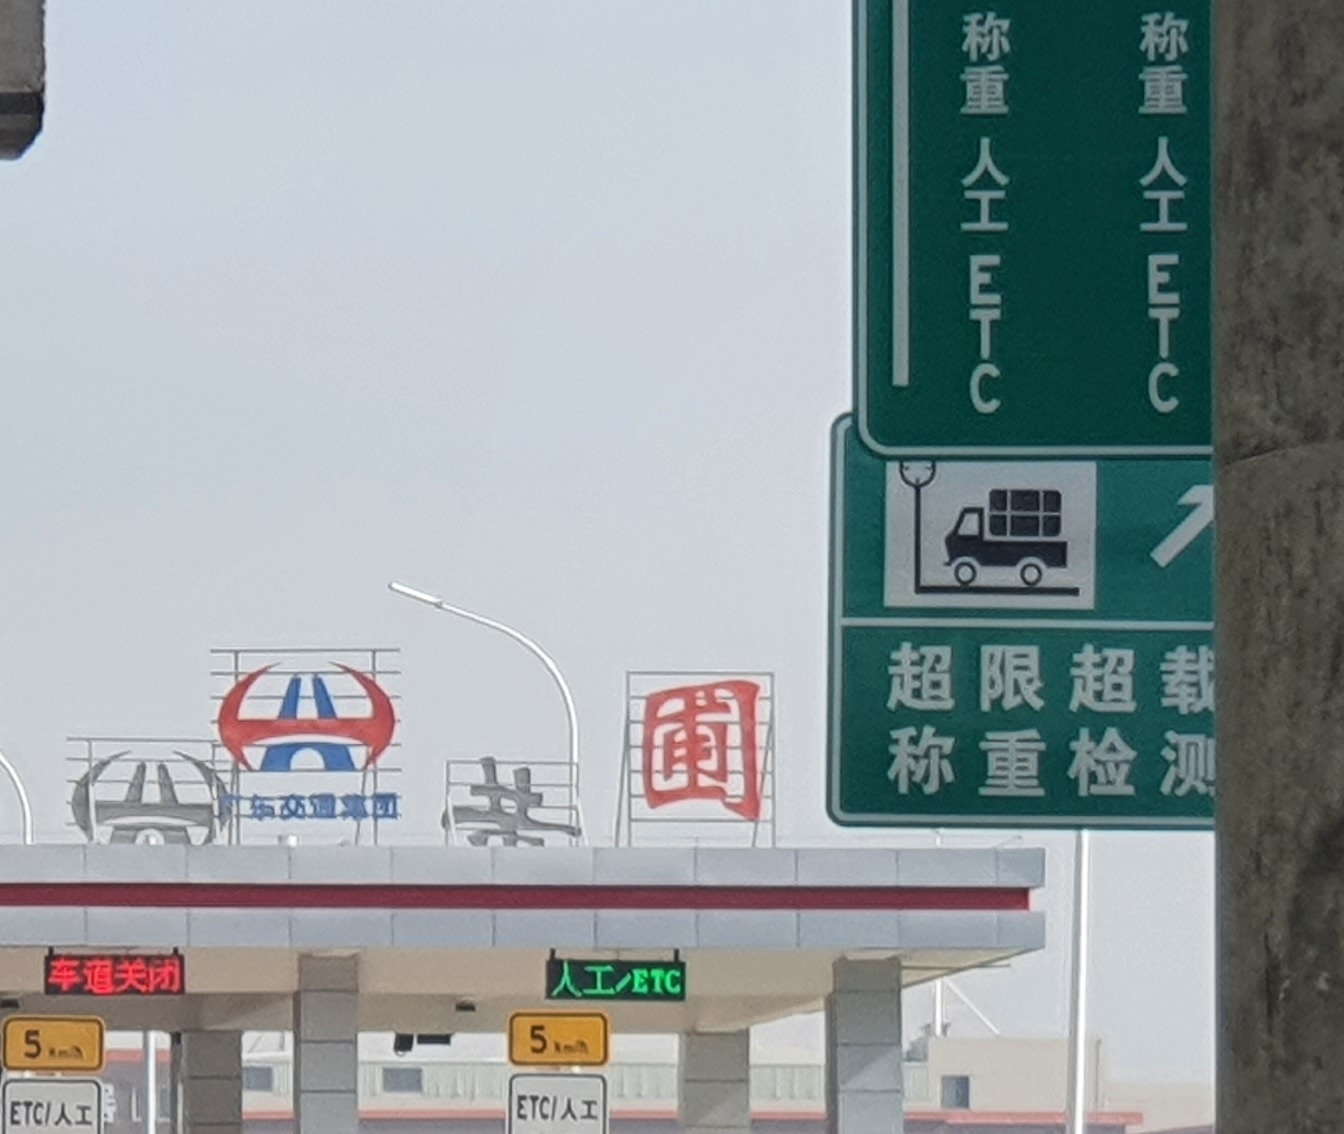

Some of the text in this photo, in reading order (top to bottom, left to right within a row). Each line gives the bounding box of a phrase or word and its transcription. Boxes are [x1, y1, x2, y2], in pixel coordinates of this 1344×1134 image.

[961, 12, 1011, 414] 称重 人工 ETC
[1138, 12, 1189, 413] 称重 人工 ETC
[887, 642, 1213, 714] 超限超载
[887, 725, 1214, 797] 称重检测
[48, 956, 181, 996] 车道关闭
[551, 959, 681, 997] 人工/ETC
[24, 1029, 42, 1060] 5
[529, 1025, 548, 1054] 5
[9, 1101, 93, 1127] ETC/人工
[517, 1094, 598, 1121] ETC/人工
